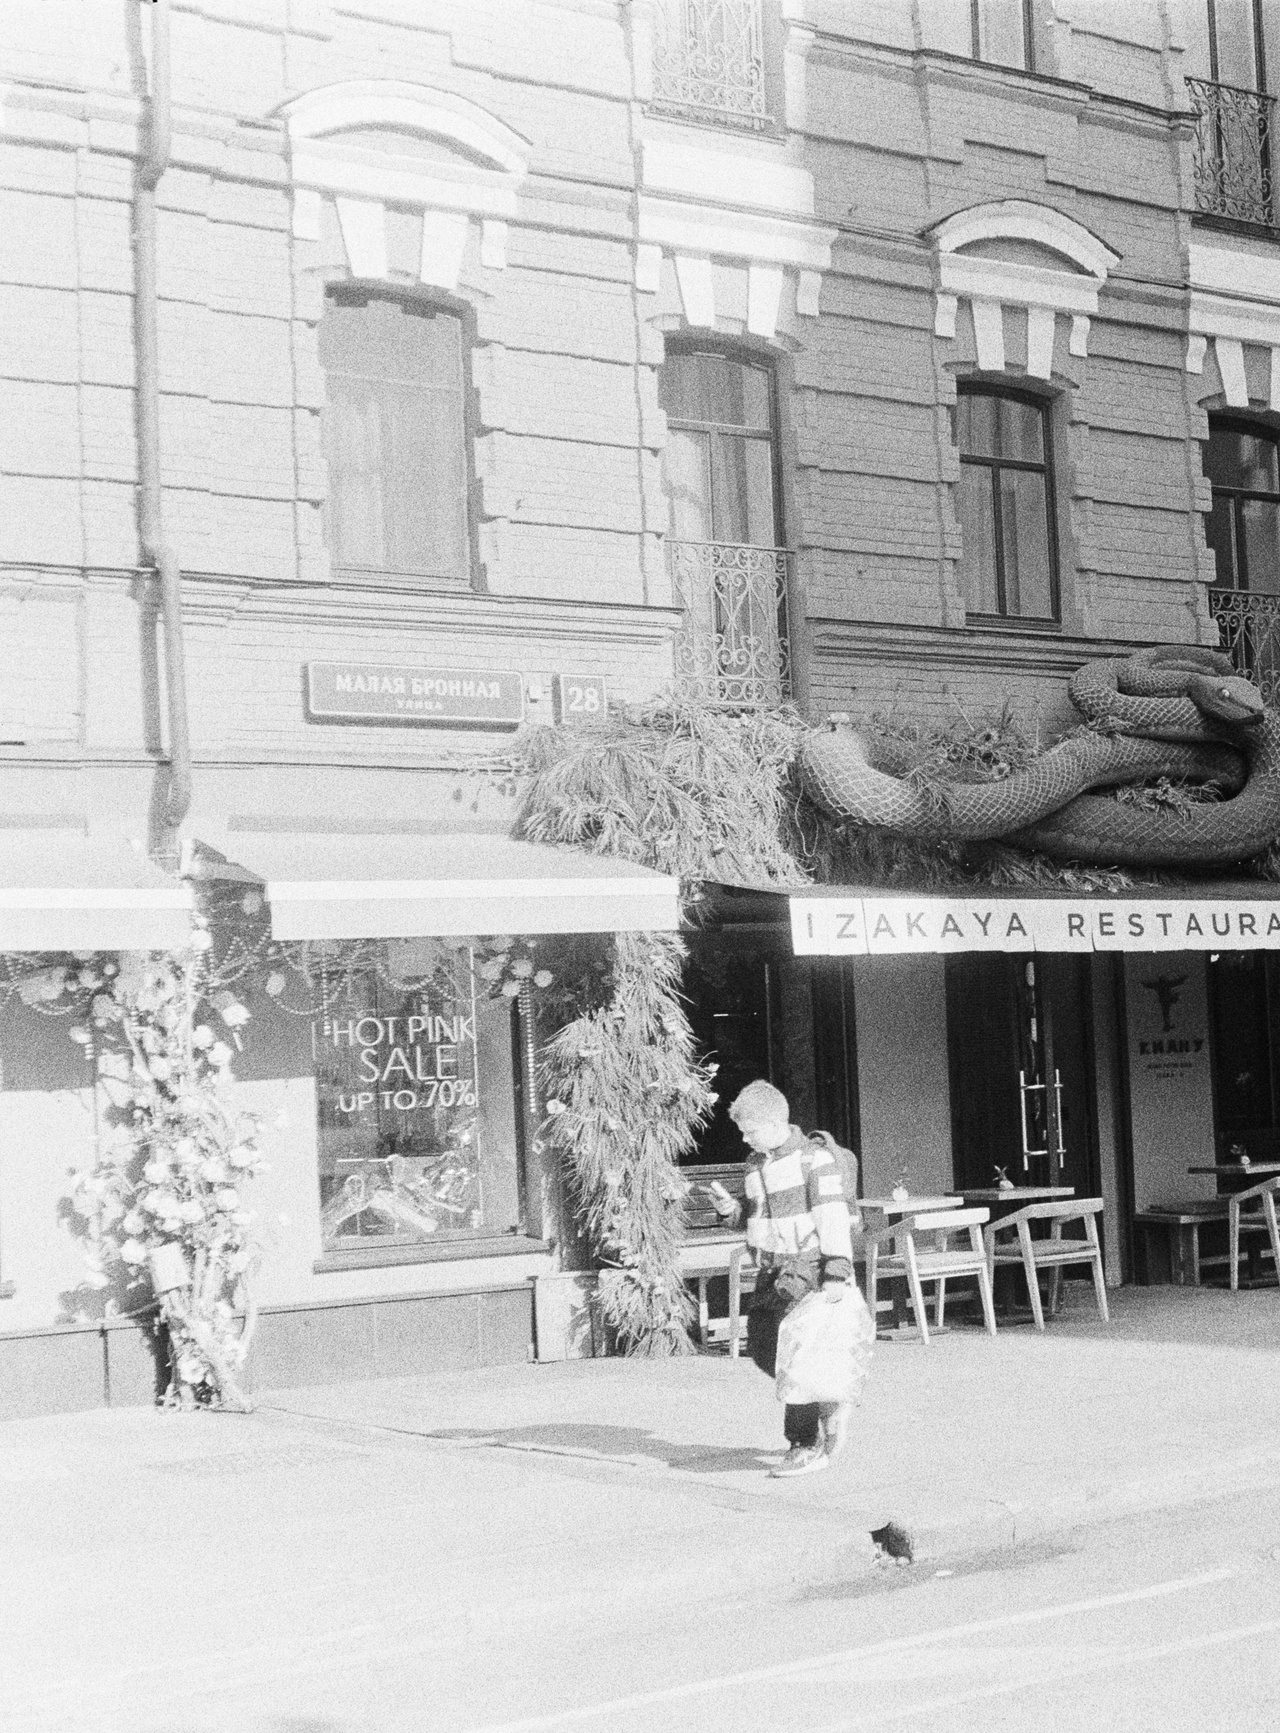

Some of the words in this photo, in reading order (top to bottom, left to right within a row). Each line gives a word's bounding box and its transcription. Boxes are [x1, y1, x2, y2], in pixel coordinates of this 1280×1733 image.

[335, 674, 405, 694] МАЛАЯ
[411, 678, 501, 699] БРОННАЯ
[567, 686, 601, 712] 28
[397, 699, 443, 711] УЛИЦА
[806, 912, 1028, 940] IZAKAYA
[333, 1017, 399, 1047] HOT
[409, 1016, 475, 1044] PINK
[359, 1045, 458, 1082] SALE
[339, 1092, 374, 1112] UP
[380, 1090, 416, 1110] TO
[424, 1079, 476, 1107] 70%
